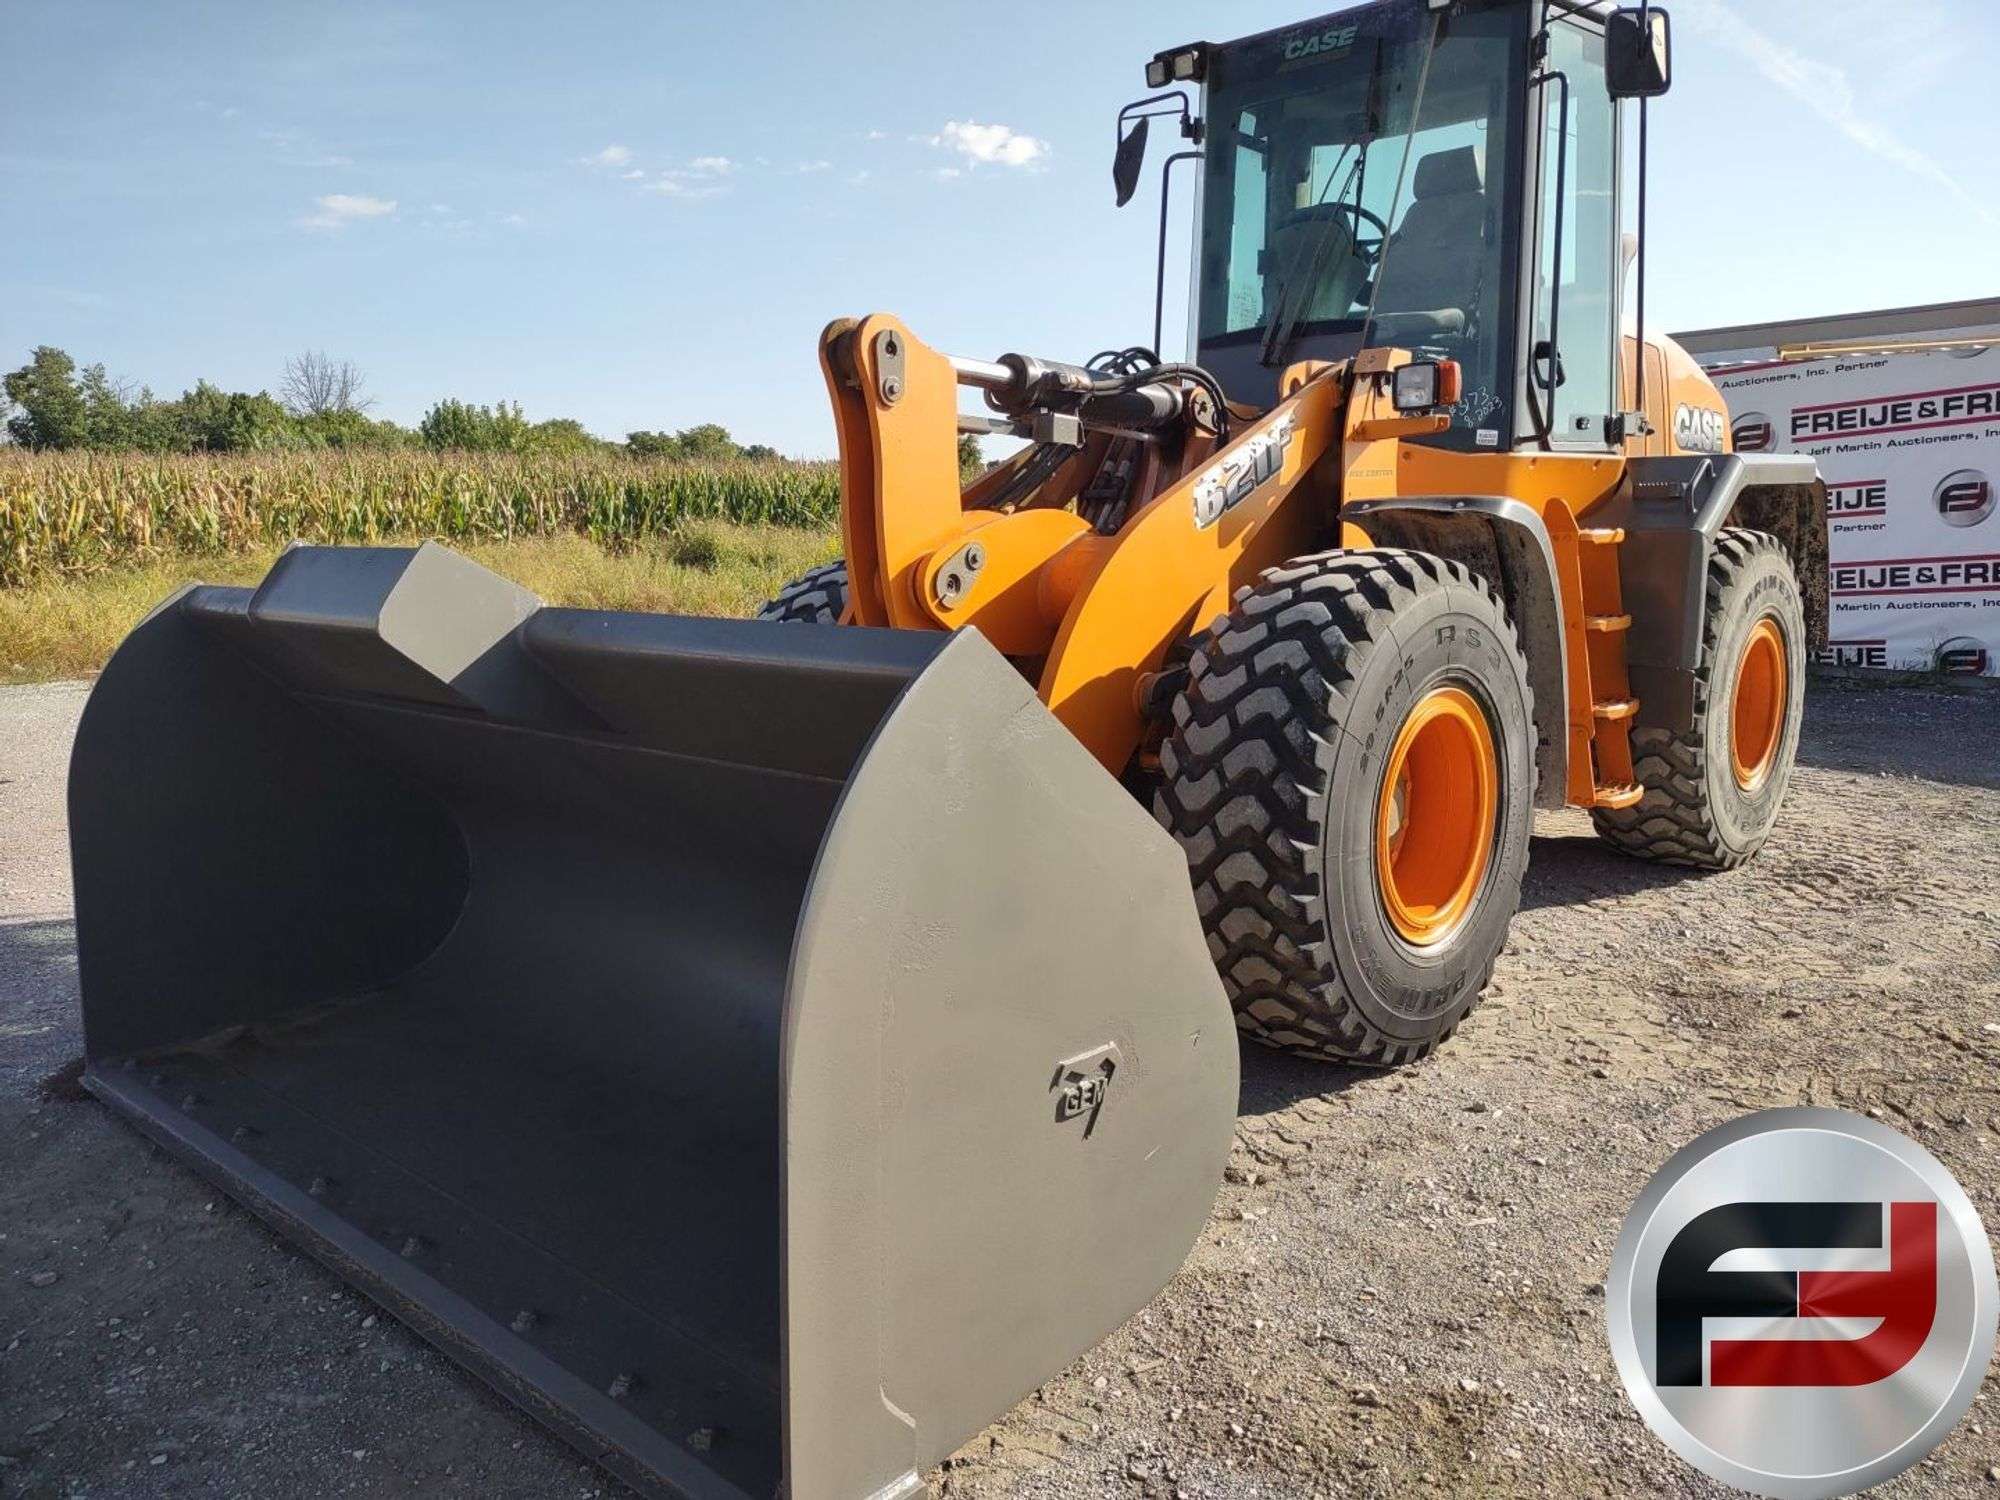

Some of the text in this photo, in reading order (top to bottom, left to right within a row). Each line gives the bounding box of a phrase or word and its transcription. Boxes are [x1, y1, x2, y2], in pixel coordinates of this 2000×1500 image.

[1285, 25, 1358, 59] CASE
[1721, 359, 1888, 389] Auctioneers, Inc. Partner
[1791, 391, 2000, 436] FREIJE & FR
[1675, 402, 1725, 453] CASE
[1836, 442, 1881, 454] Martin
[1887, 432, 1979, 448] Auctioneers,
[1834, 523, 1886, 533] Partner
[1831, 566, 1910, 589] EIJE
[1916, 566, 1936, 583] &
[1836, 602, 1880, 612] Martin
[1886, 600, 1976, 611] Auctioneers,
